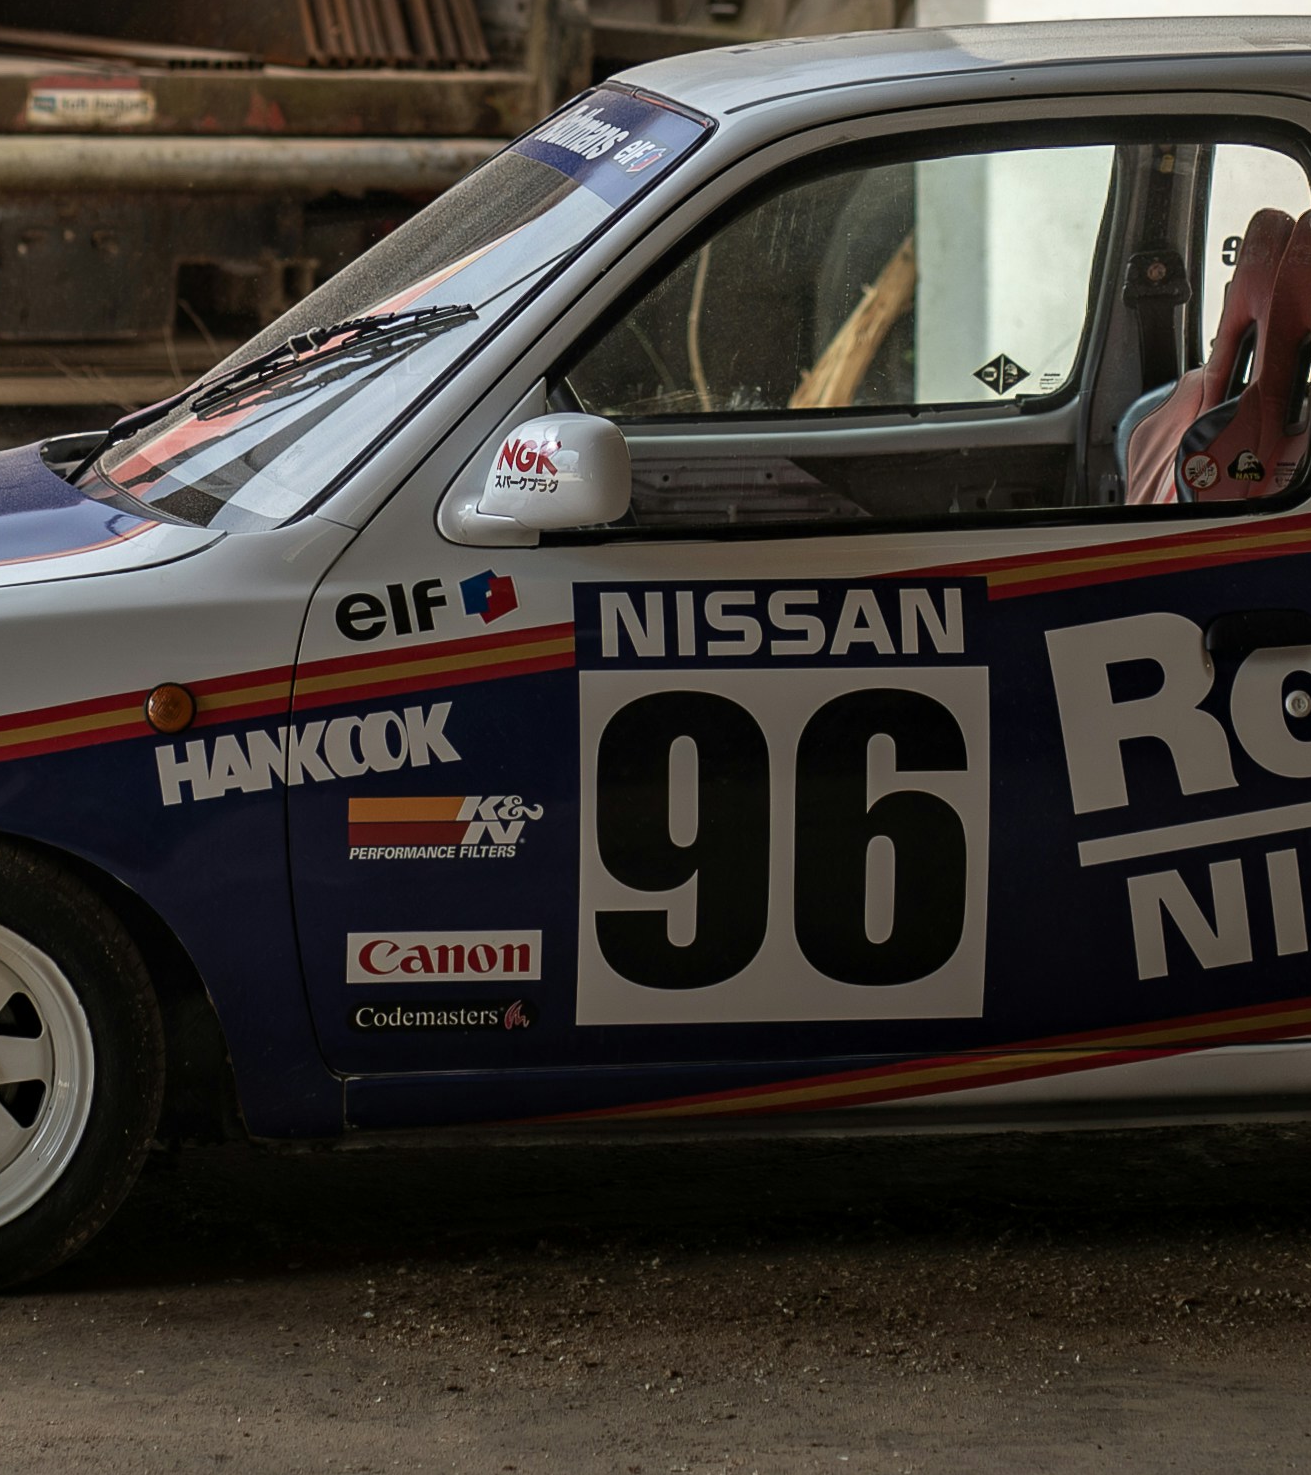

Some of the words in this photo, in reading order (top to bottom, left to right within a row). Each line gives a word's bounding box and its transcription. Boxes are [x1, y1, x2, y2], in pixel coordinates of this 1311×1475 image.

[496, 438, 563, 477] NGK
[1235, 471, 1261, 481] NATS
[494, 475, 559, 493] スパークプラグ
[335, 578, 448, 642] elf
[598, 588, 965, 658] NISSAN
[155, 701, 462, 807] HANKOOK
[349, 846, 456, 860] PERFORMANCE
[459, 845, 517, 859] FILTERS
[594, 687, 969, 991] 96
[358, 939, 531, 976] Canon
[355, 1006, 499, 1027] Codemasters
